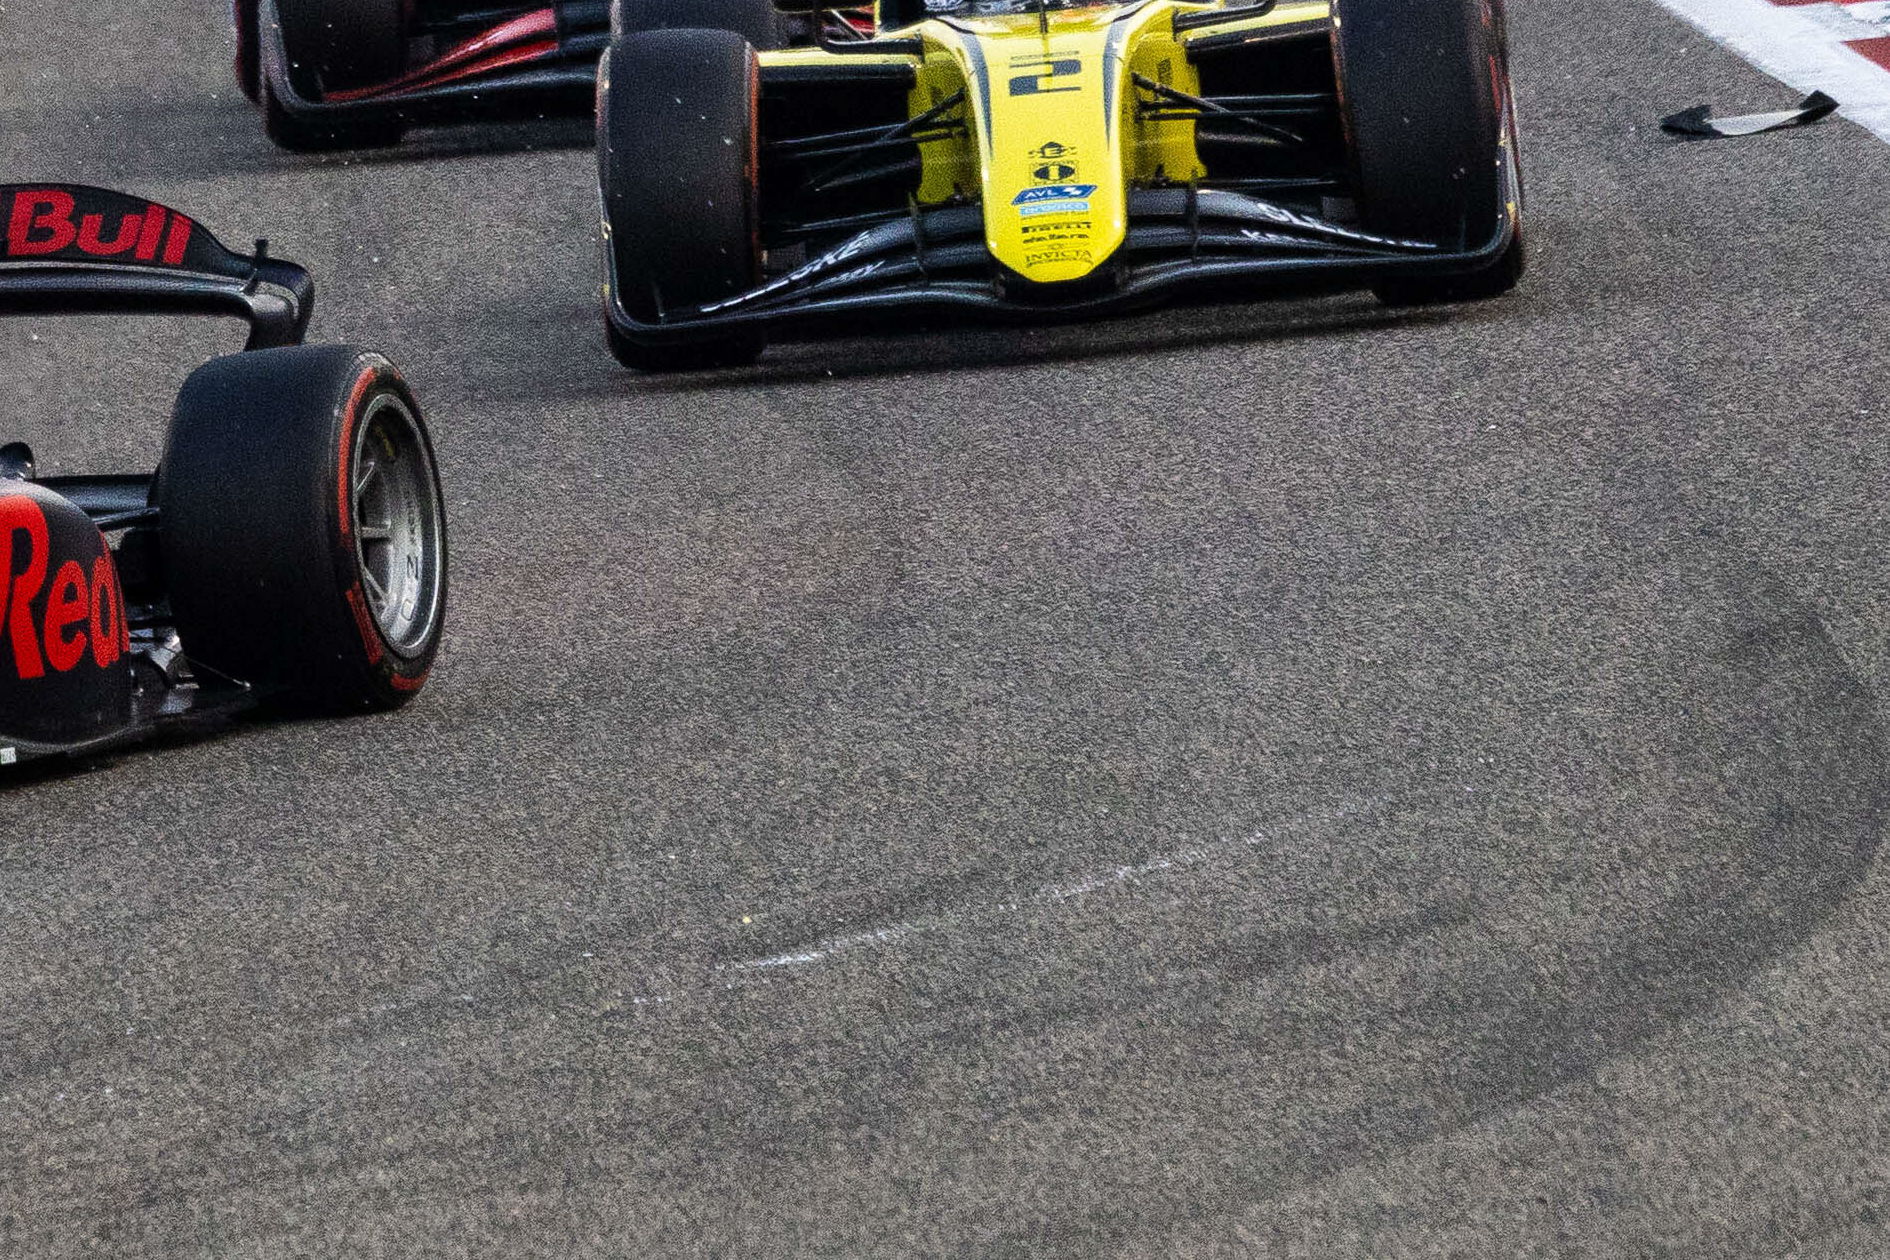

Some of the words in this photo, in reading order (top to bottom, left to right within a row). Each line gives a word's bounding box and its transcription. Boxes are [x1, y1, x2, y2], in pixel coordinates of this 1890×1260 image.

[1008, 58, 1082, 98] 2
[1024, 188, 1058, 199] AVL
[8, 189, 193, 266] Bull
[1024, 250, 1093, 265] INVICTA
